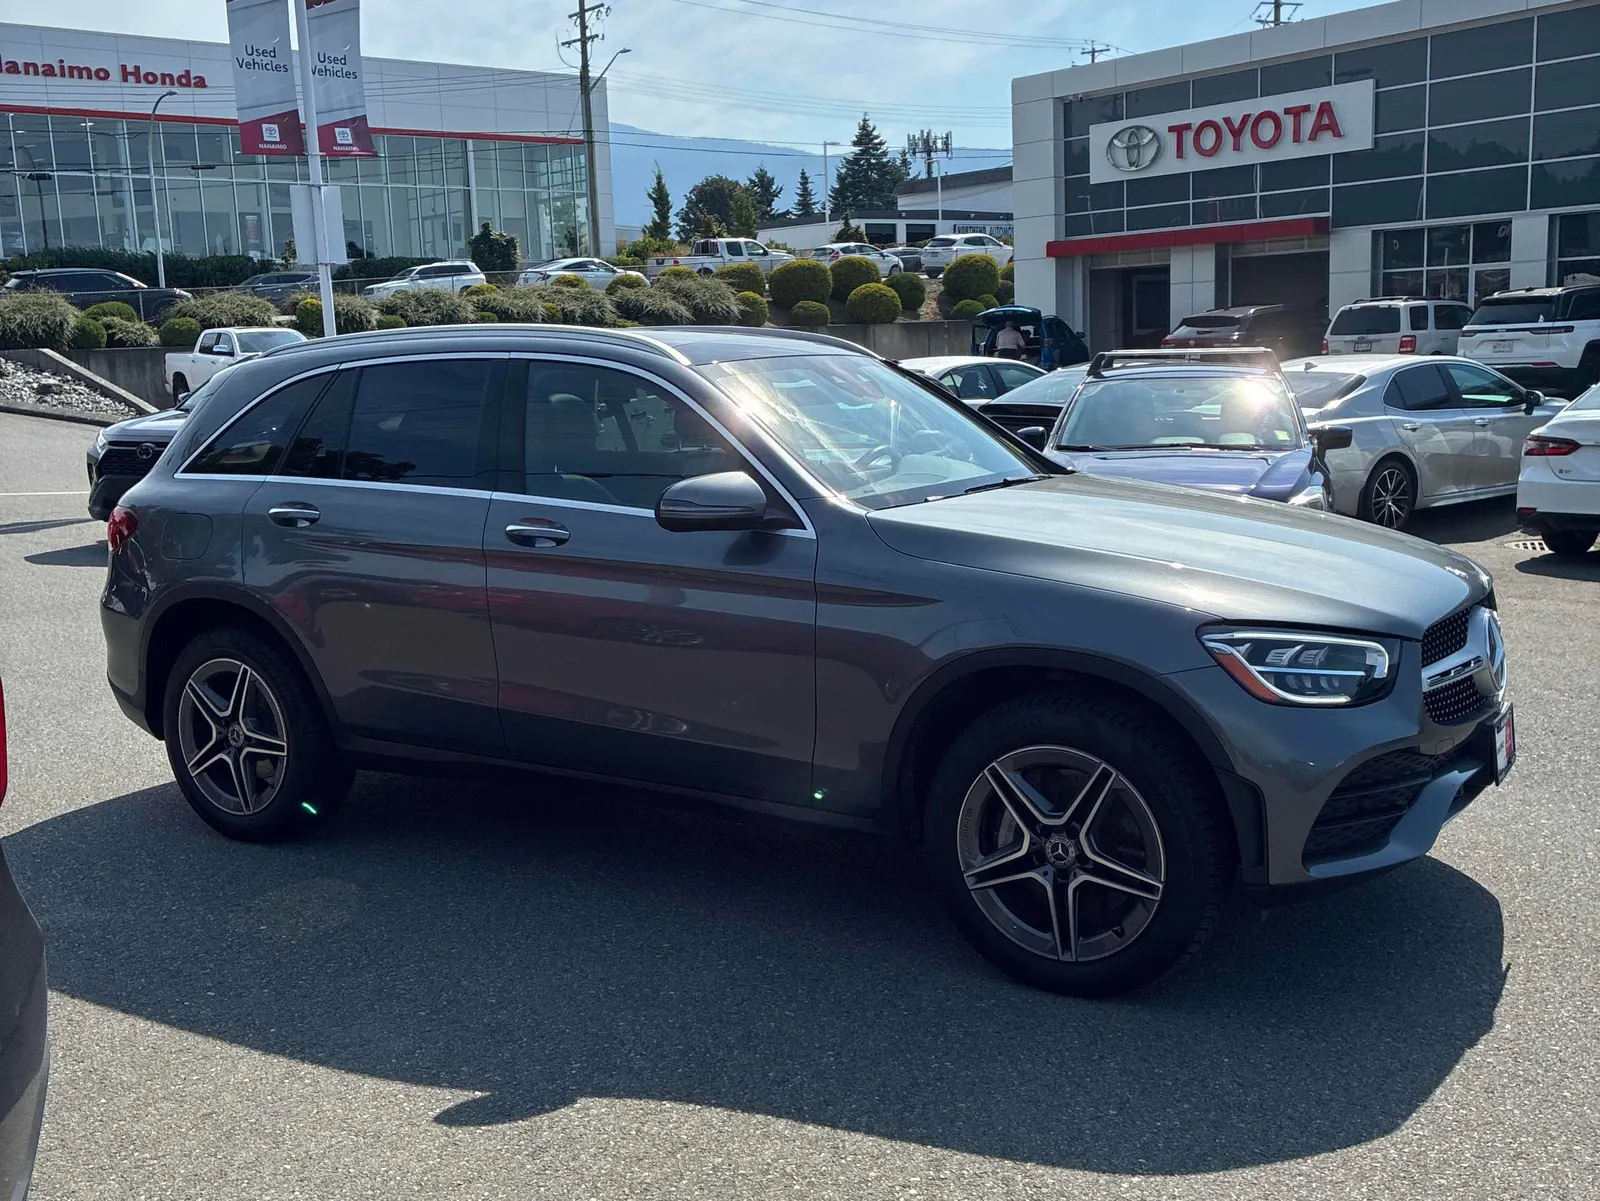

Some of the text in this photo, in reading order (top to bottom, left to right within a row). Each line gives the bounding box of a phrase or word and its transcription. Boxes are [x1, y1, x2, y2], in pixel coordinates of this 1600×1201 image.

[244, 44, 277, 58] Used
[236, 57, 289, 73] Vehicles
[317, 52, 347, 66] Used
[0, 54, 208, 88] anaimo Honda
[311, 65, 358, 80] Vehicles
[1167, 101, 1345, 160] TOYOTA
